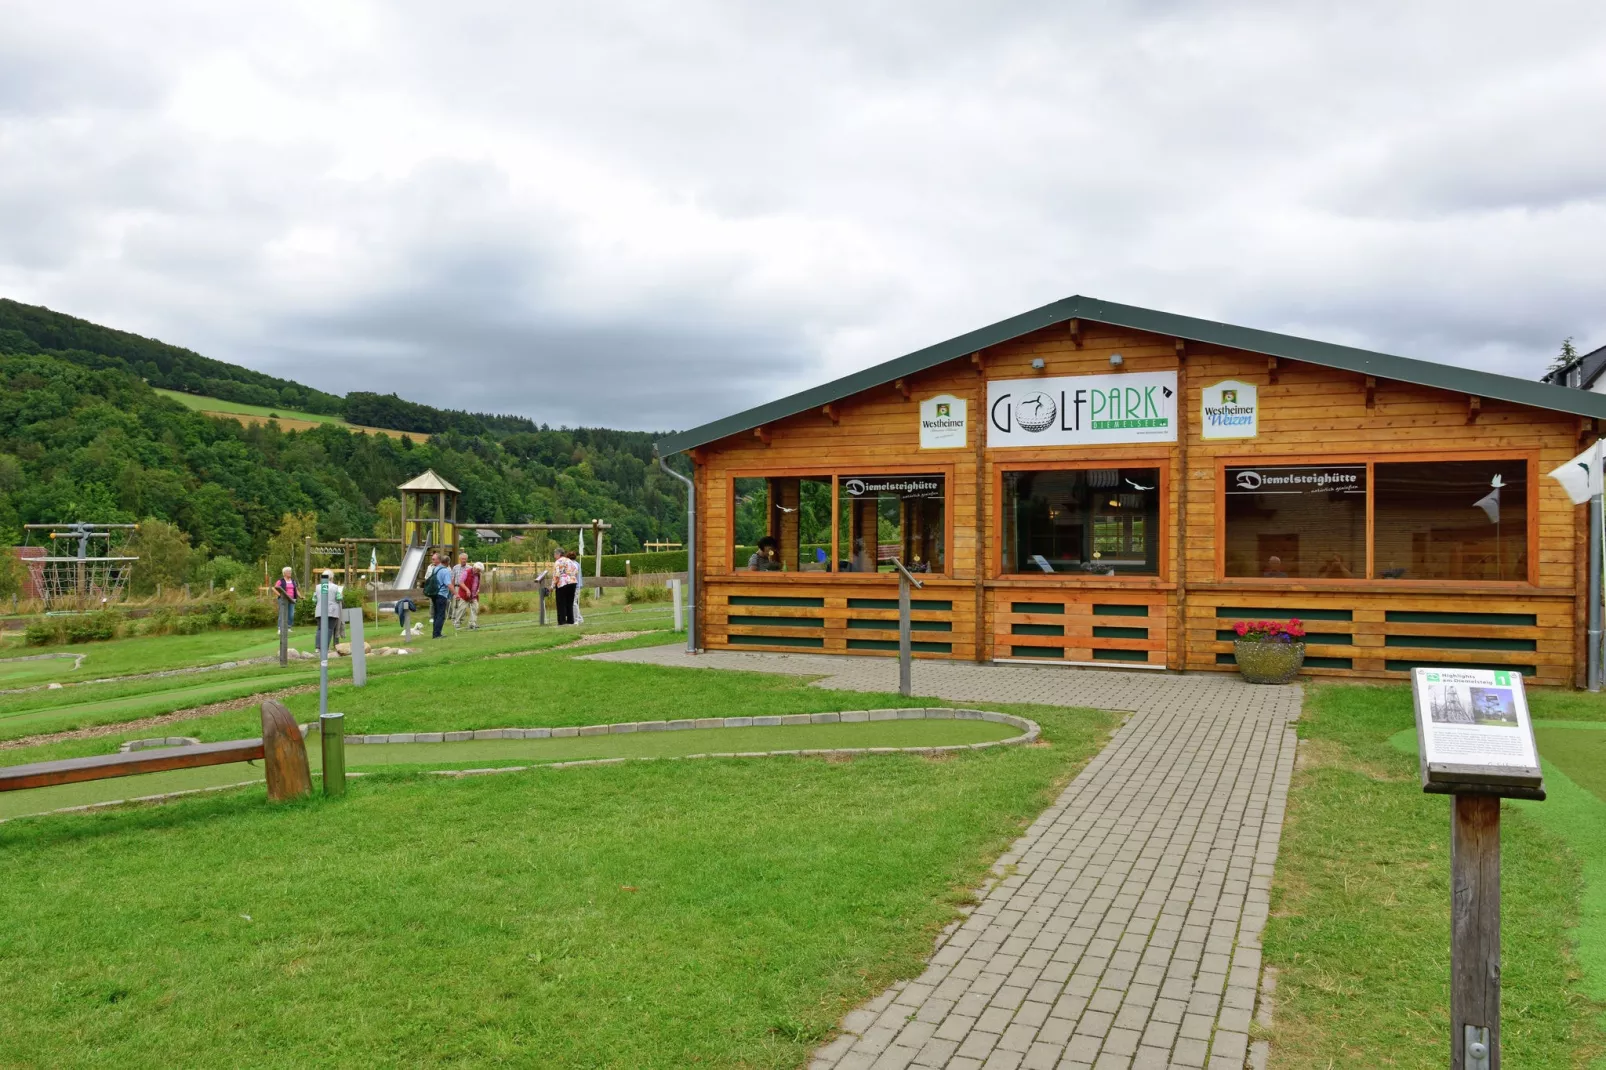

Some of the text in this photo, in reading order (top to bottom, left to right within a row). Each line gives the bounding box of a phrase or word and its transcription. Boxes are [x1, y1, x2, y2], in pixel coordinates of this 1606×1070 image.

[1205, 405, 1254, 416] Westheimer
[922, 418, 964, 428] Westheimer
[1093, 420, 1156, 429] DIEMELSEE
[1208, 413, 1253, 426] Weizen
[1236, 471, 1357, 489] Diemelsteighütte
[846, 479, 938, 496] Diemelsteighütte
[1499, 676, 1507, 686] 1
